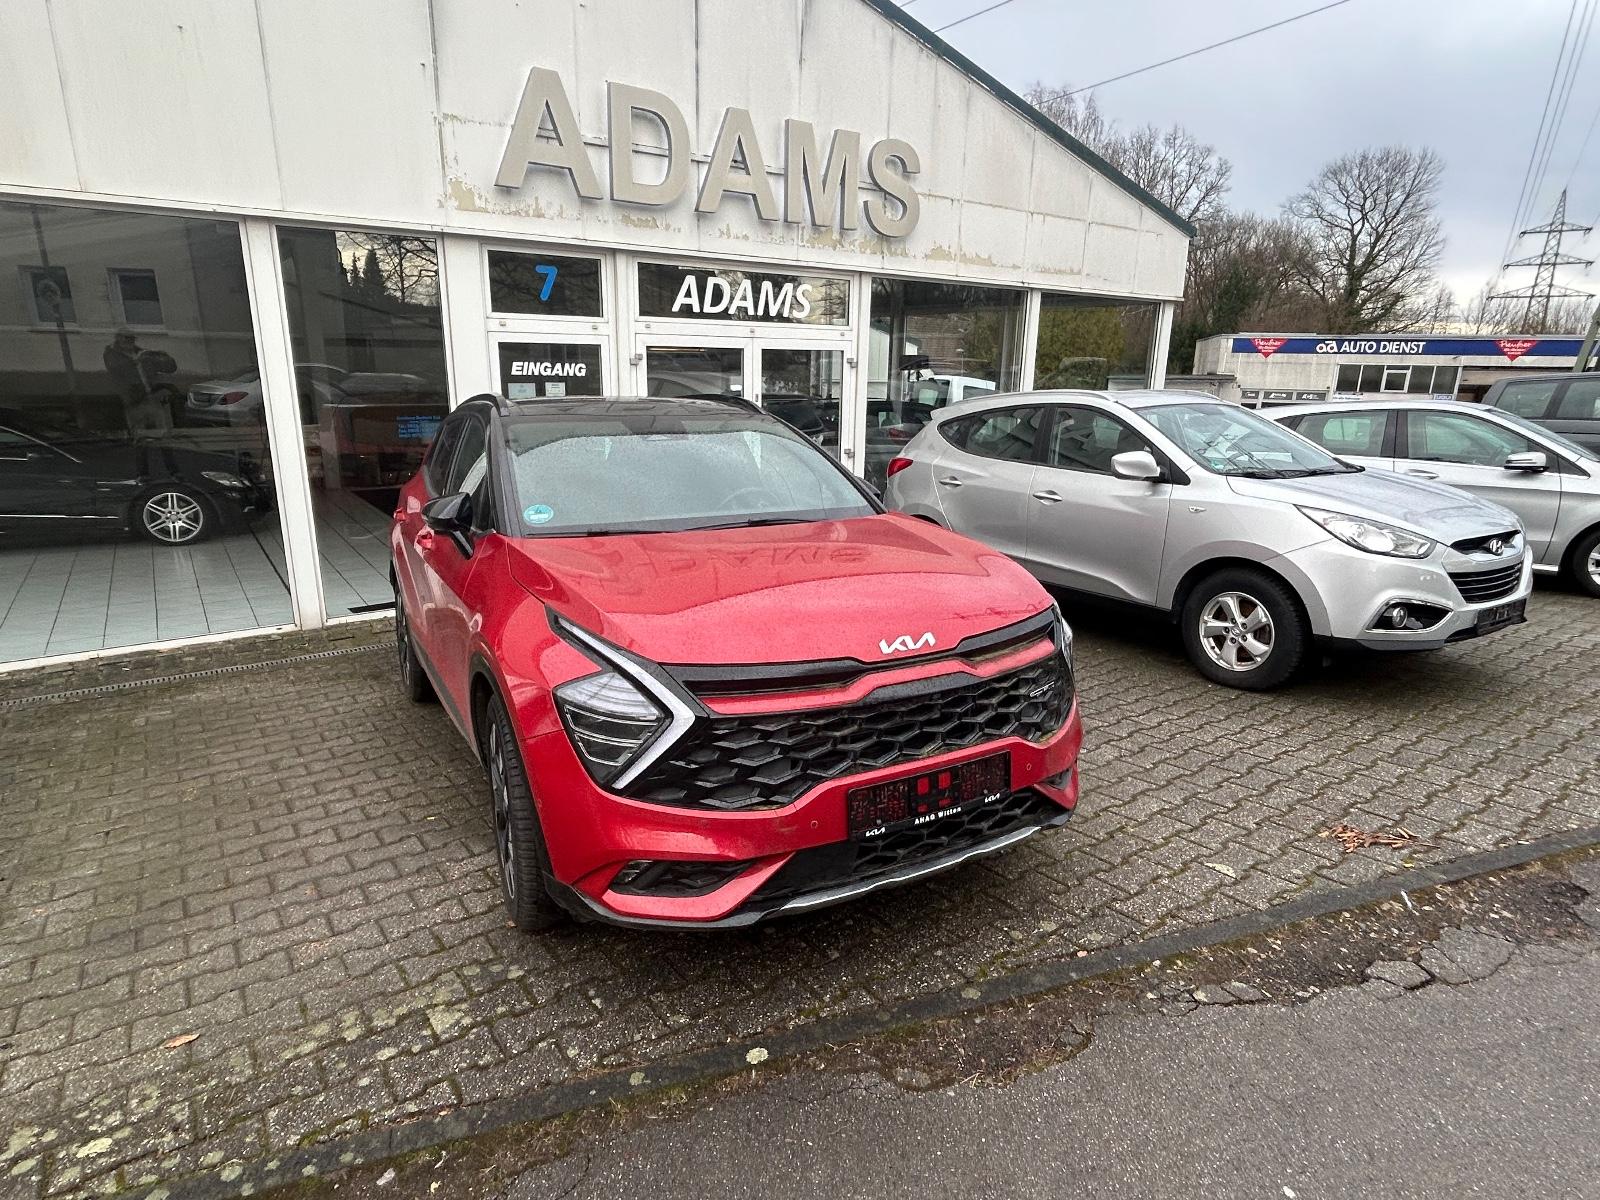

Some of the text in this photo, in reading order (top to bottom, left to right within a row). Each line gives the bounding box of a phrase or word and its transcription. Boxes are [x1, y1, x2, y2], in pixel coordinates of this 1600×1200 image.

[493, 65, 921, 238] ADAMS
[535, 264, 558, 301] 7
[671, 274, 813, 319] ADAMS
[1339, 340, 1378, 354] AUTO
[1379, 340, 1427, 354] DIENST
[510, 361, 587, 377] EINGANG
[937, 806, 962, 819] Witten
